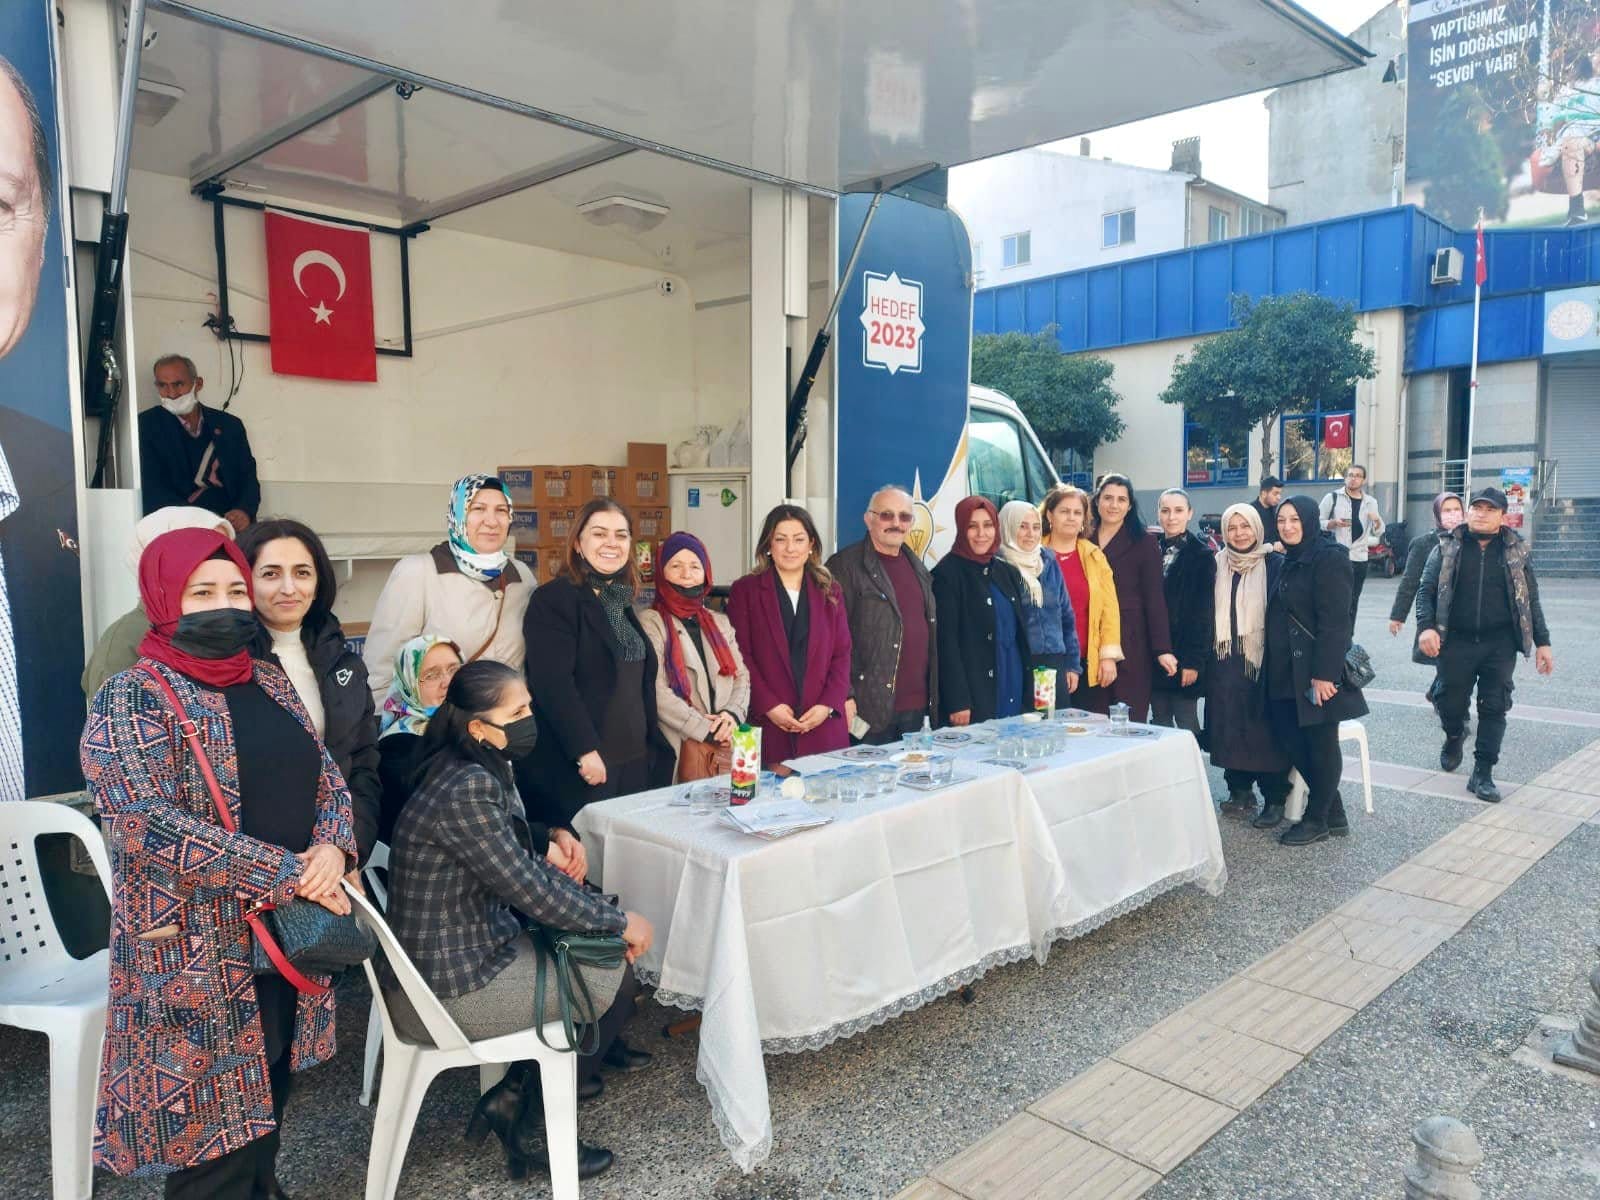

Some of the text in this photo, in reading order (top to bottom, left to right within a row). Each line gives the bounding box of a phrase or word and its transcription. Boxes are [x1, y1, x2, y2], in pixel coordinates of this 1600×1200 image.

[1430, 5, 1507, 41] YAPTIĞIMIZ
[1430, 21, 1538, 68] İŞİN DOĞASINDA
[871, 295, 917, 321] HEDEF
[870, 320, 916, 350] 2023
